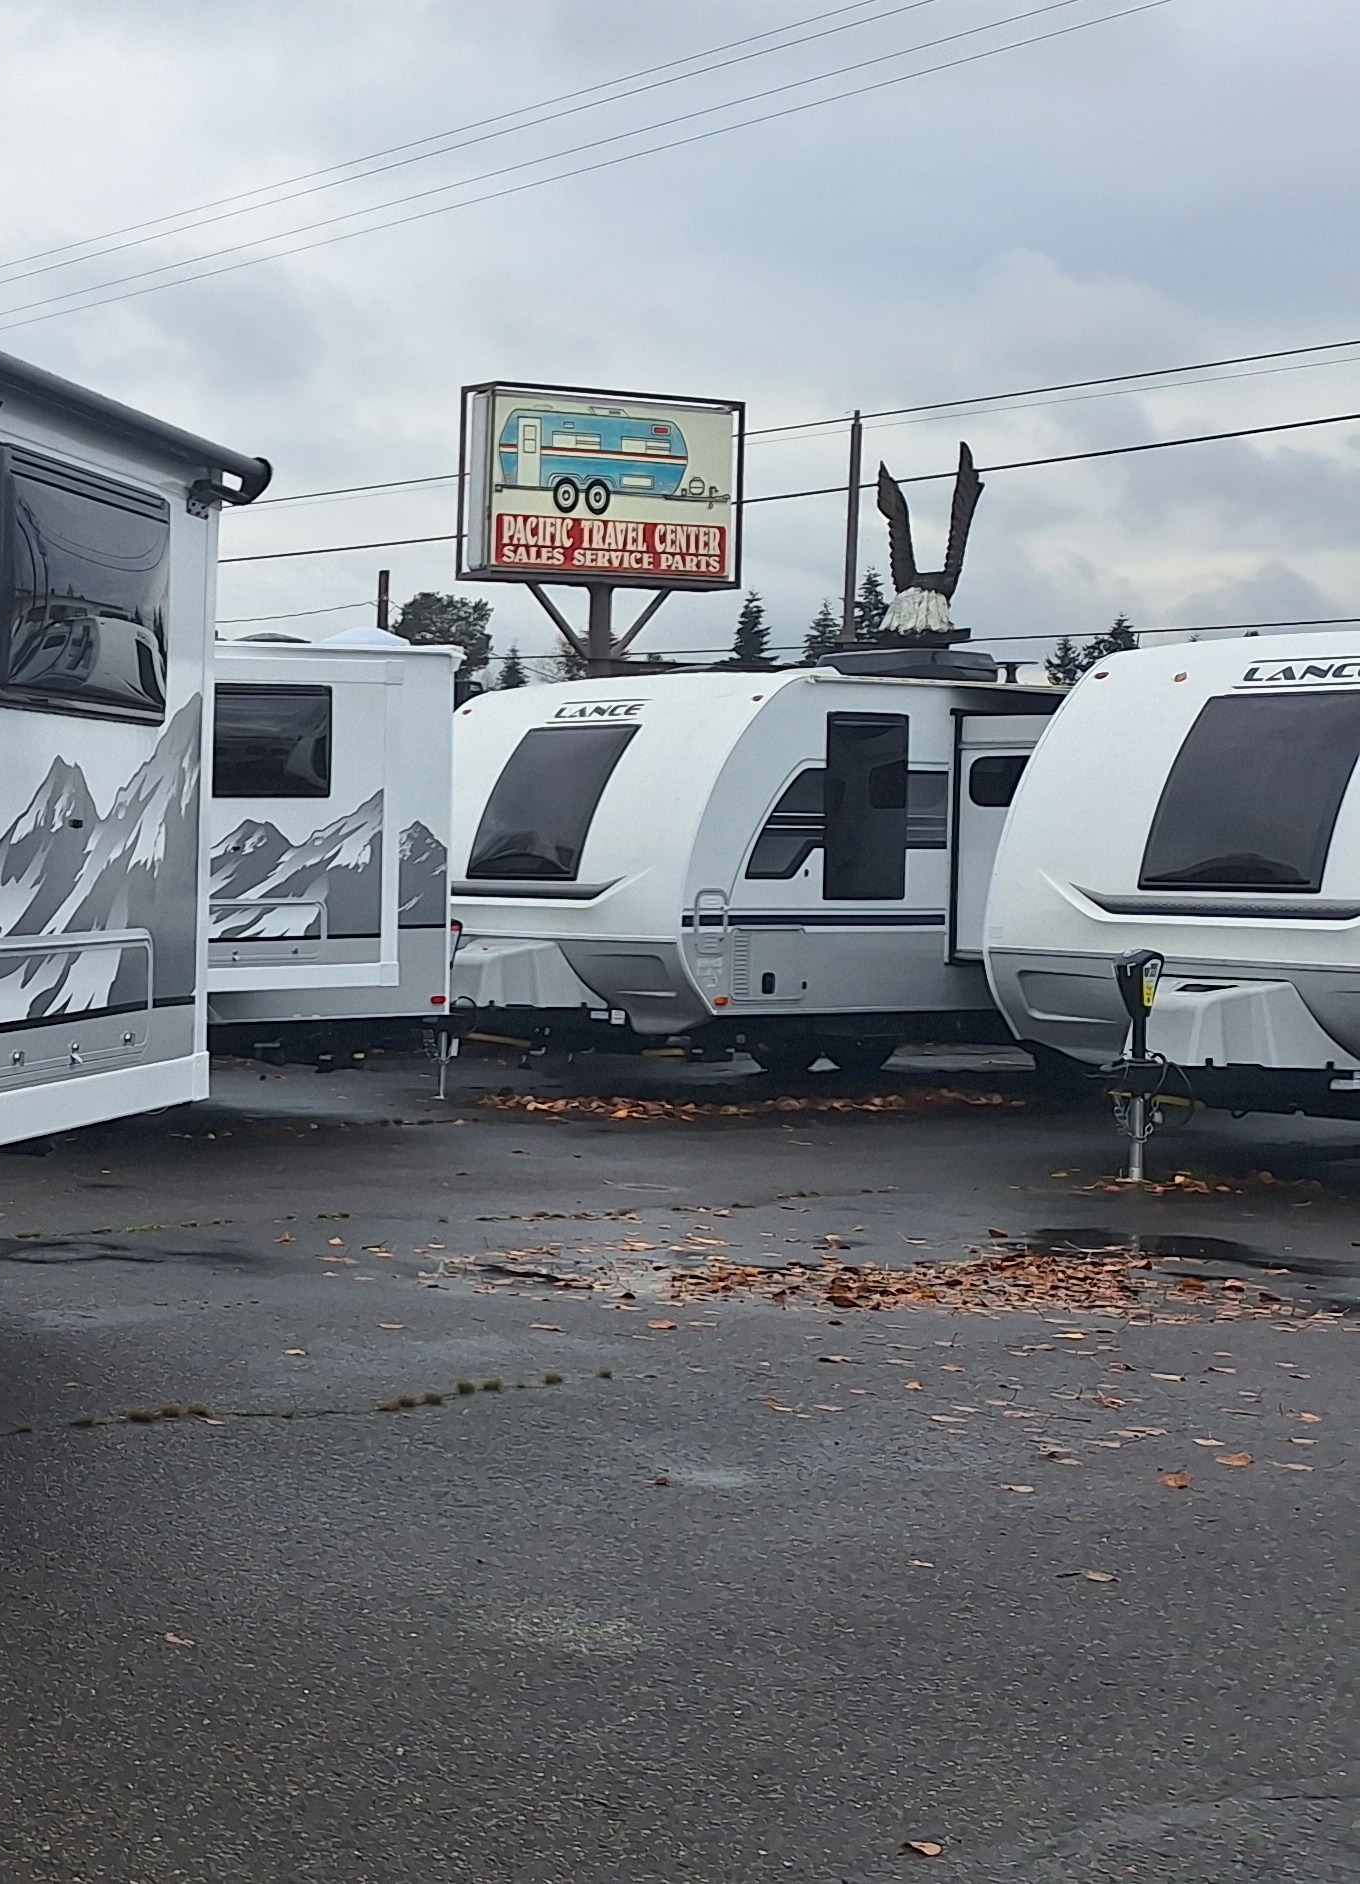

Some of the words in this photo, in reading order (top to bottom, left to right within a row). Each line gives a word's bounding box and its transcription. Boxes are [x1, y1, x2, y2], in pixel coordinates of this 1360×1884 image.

[502, 515, 573, 547] PACIFIC
[581, 520, 647, 551] TRAVEL
[654, 524, 721, 554] CENTER
[502, 546, 565, 565] SALES
[572, 549, 654, 569] SERVICE
[660, 554, 720, 572] PARTS
[1243, 663, 1360, 681] LANC
[554, 704, 645, 718] LANCE
